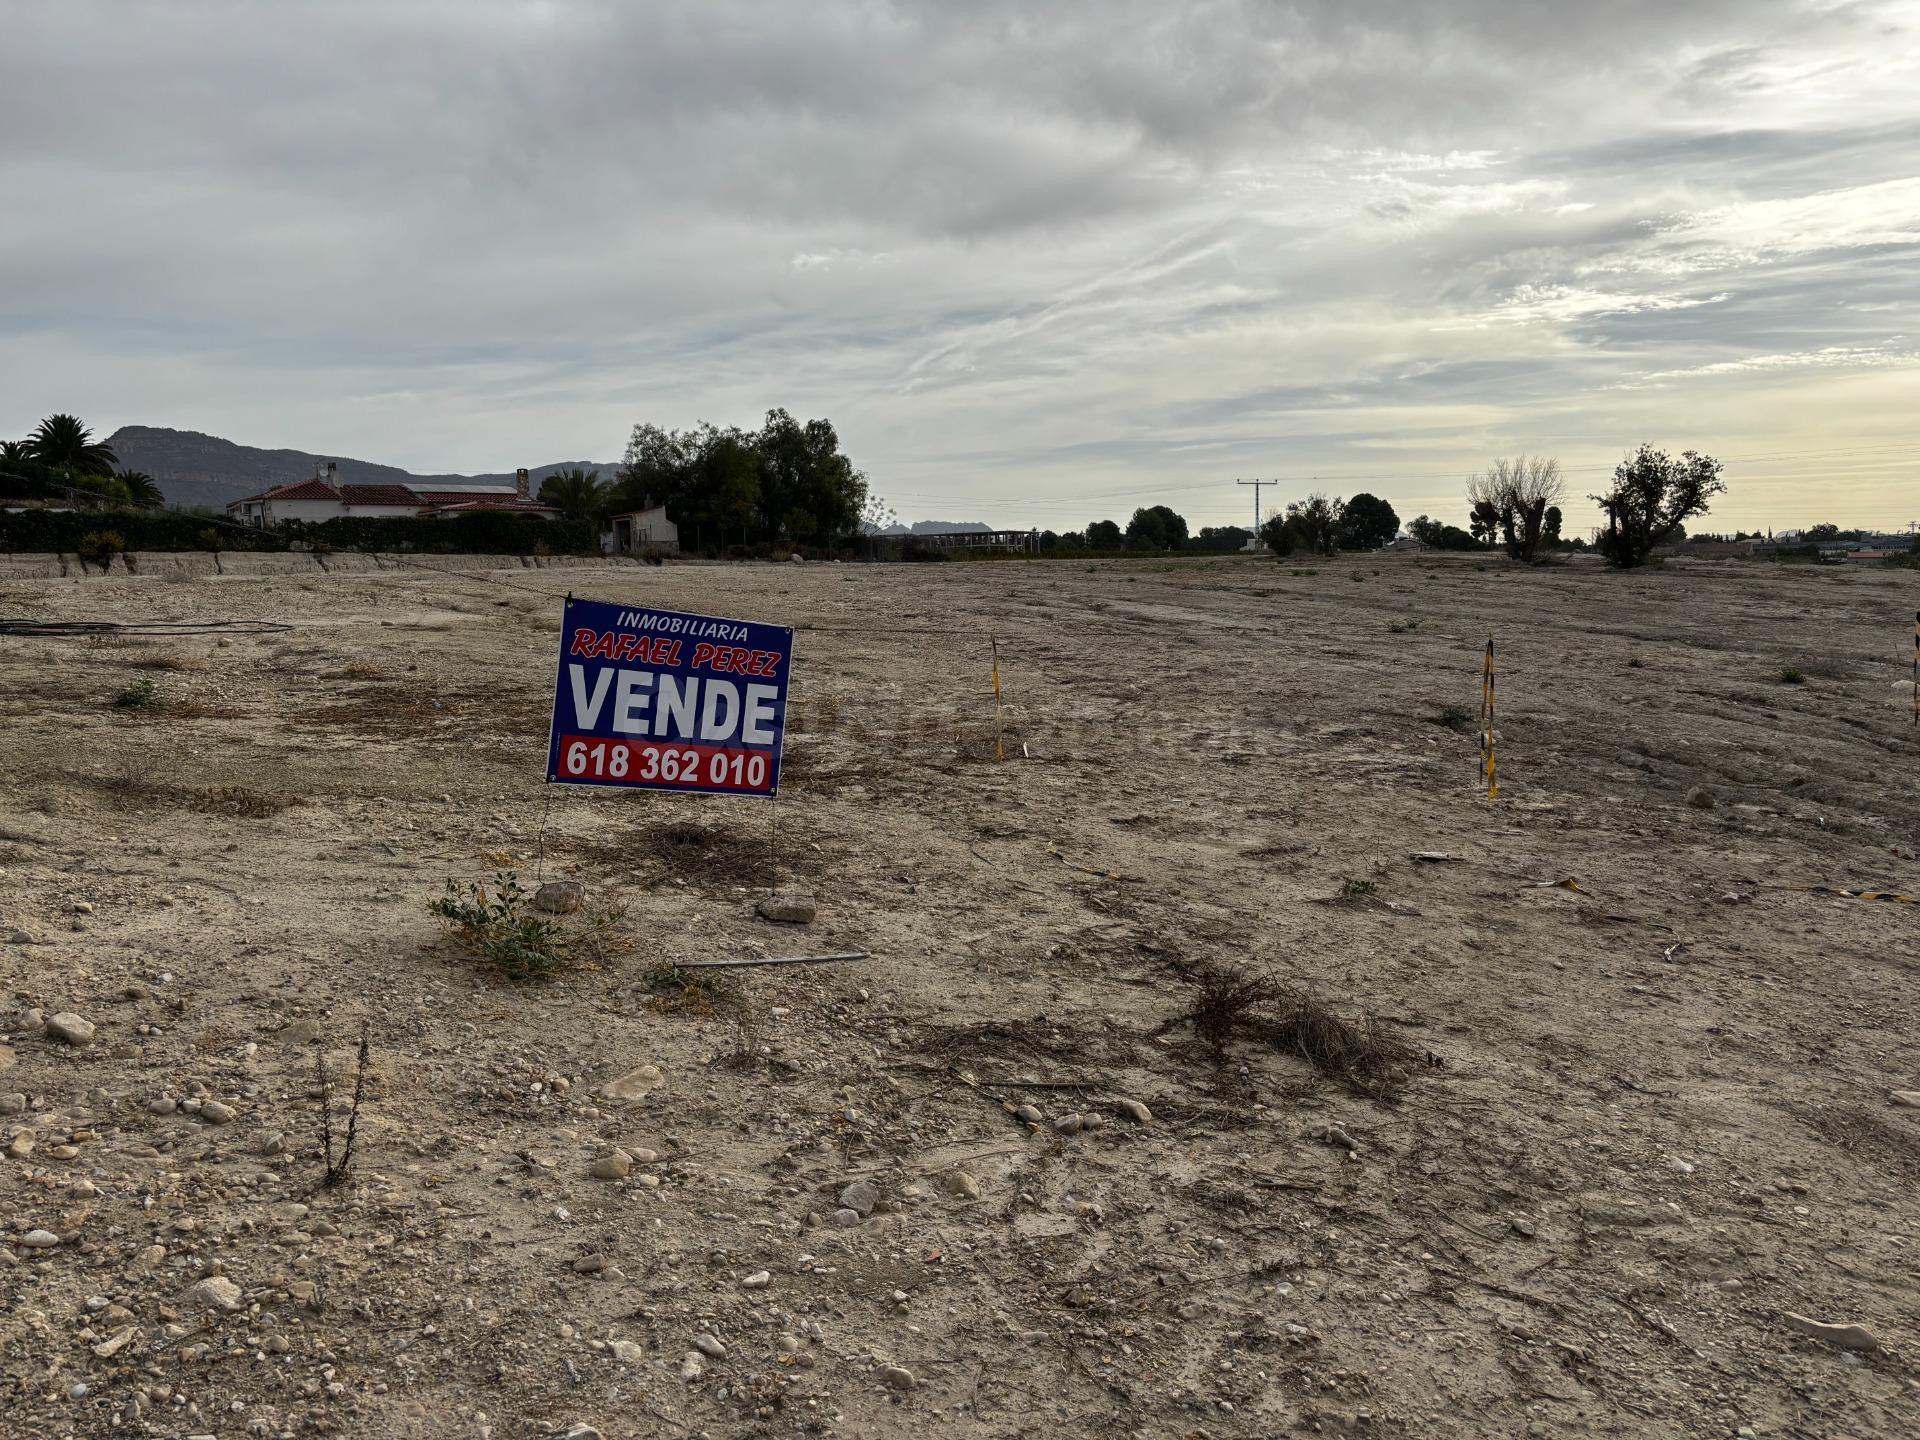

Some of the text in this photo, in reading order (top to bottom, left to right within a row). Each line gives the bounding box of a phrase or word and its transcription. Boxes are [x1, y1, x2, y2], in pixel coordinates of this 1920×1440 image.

[617, 611, 748, 641] INMOBILIARIA
[571, 629, 782, 677] RAFAEL PEREZ
[569, 664, 779, 745] VENDE
[567, 742, 629, 776] 618
[641, 748, 700, 782] 362
[710, 753, 765, 787] 010
